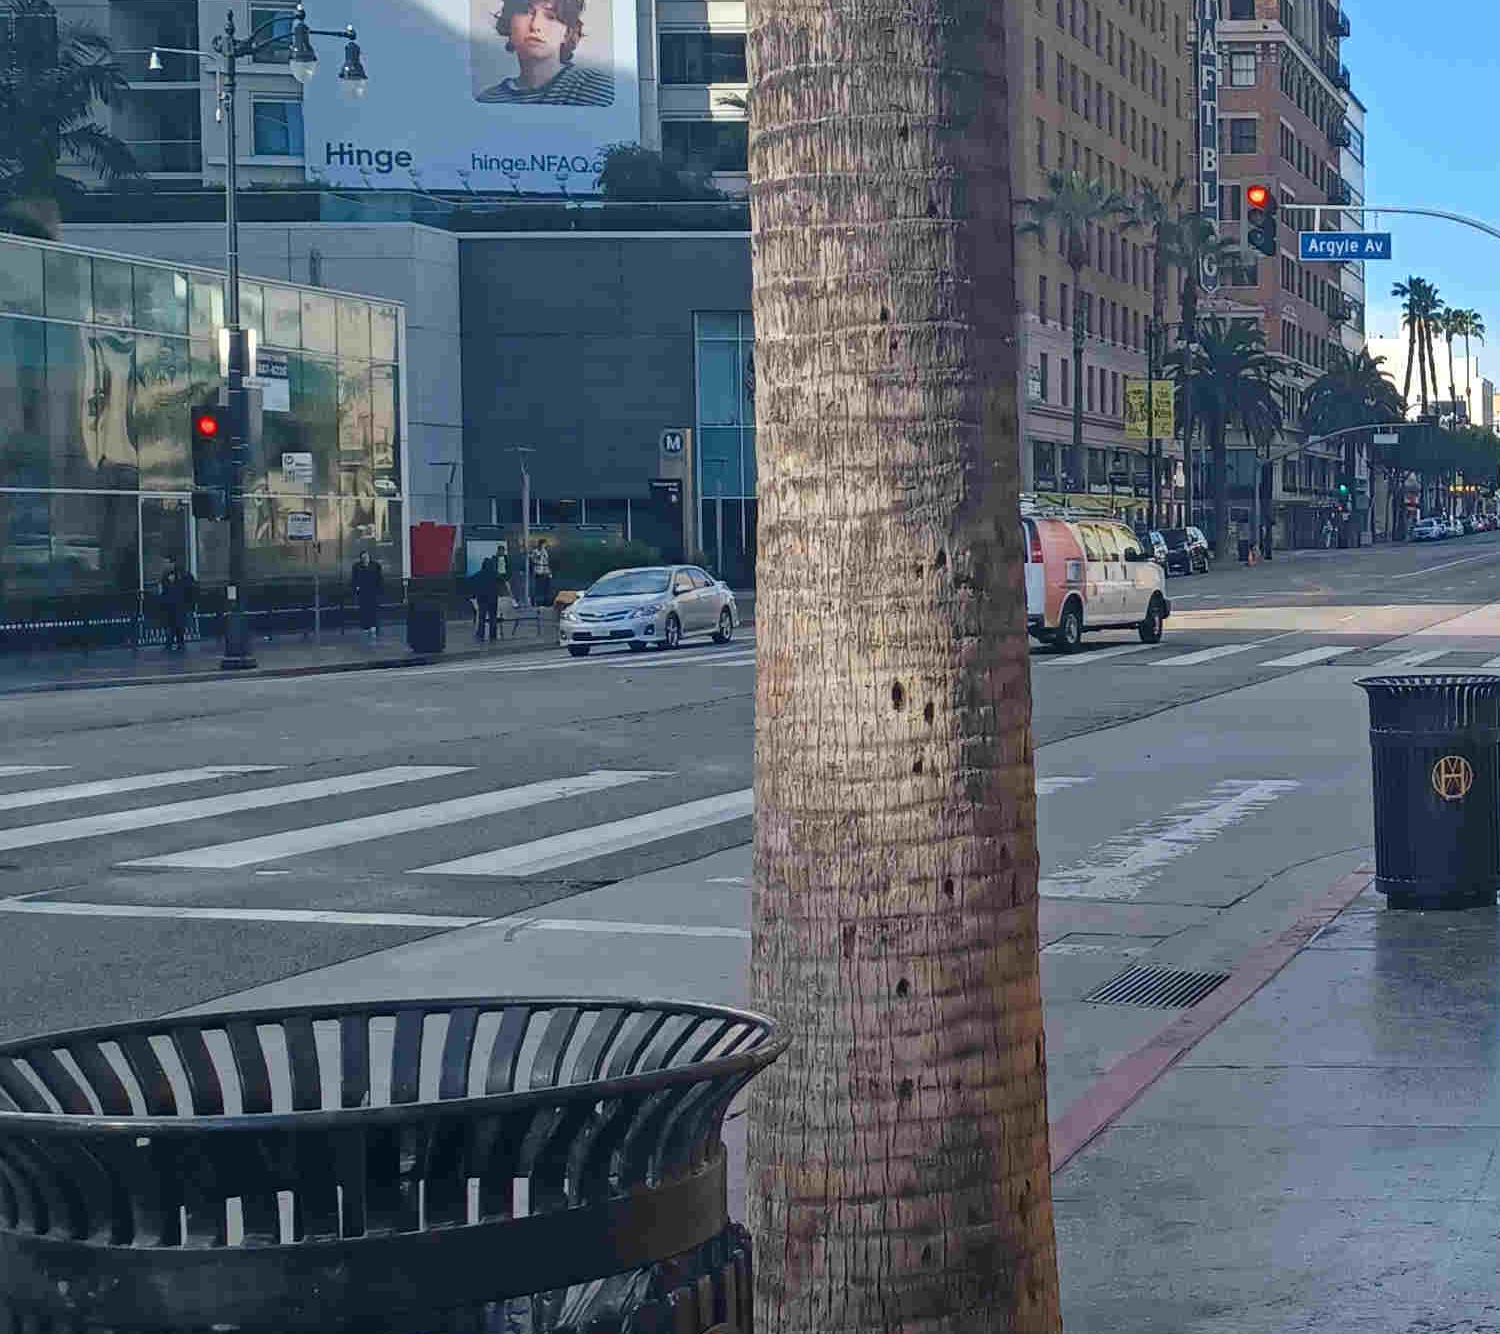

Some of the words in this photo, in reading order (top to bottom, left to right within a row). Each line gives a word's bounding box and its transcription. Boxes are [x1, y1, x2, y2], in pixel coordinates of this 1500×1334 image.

[325, 142, 413, 173] Hinge
[1308, 238, 1359, 256] Argyle
[1364, 238, 1384, 252] Av
